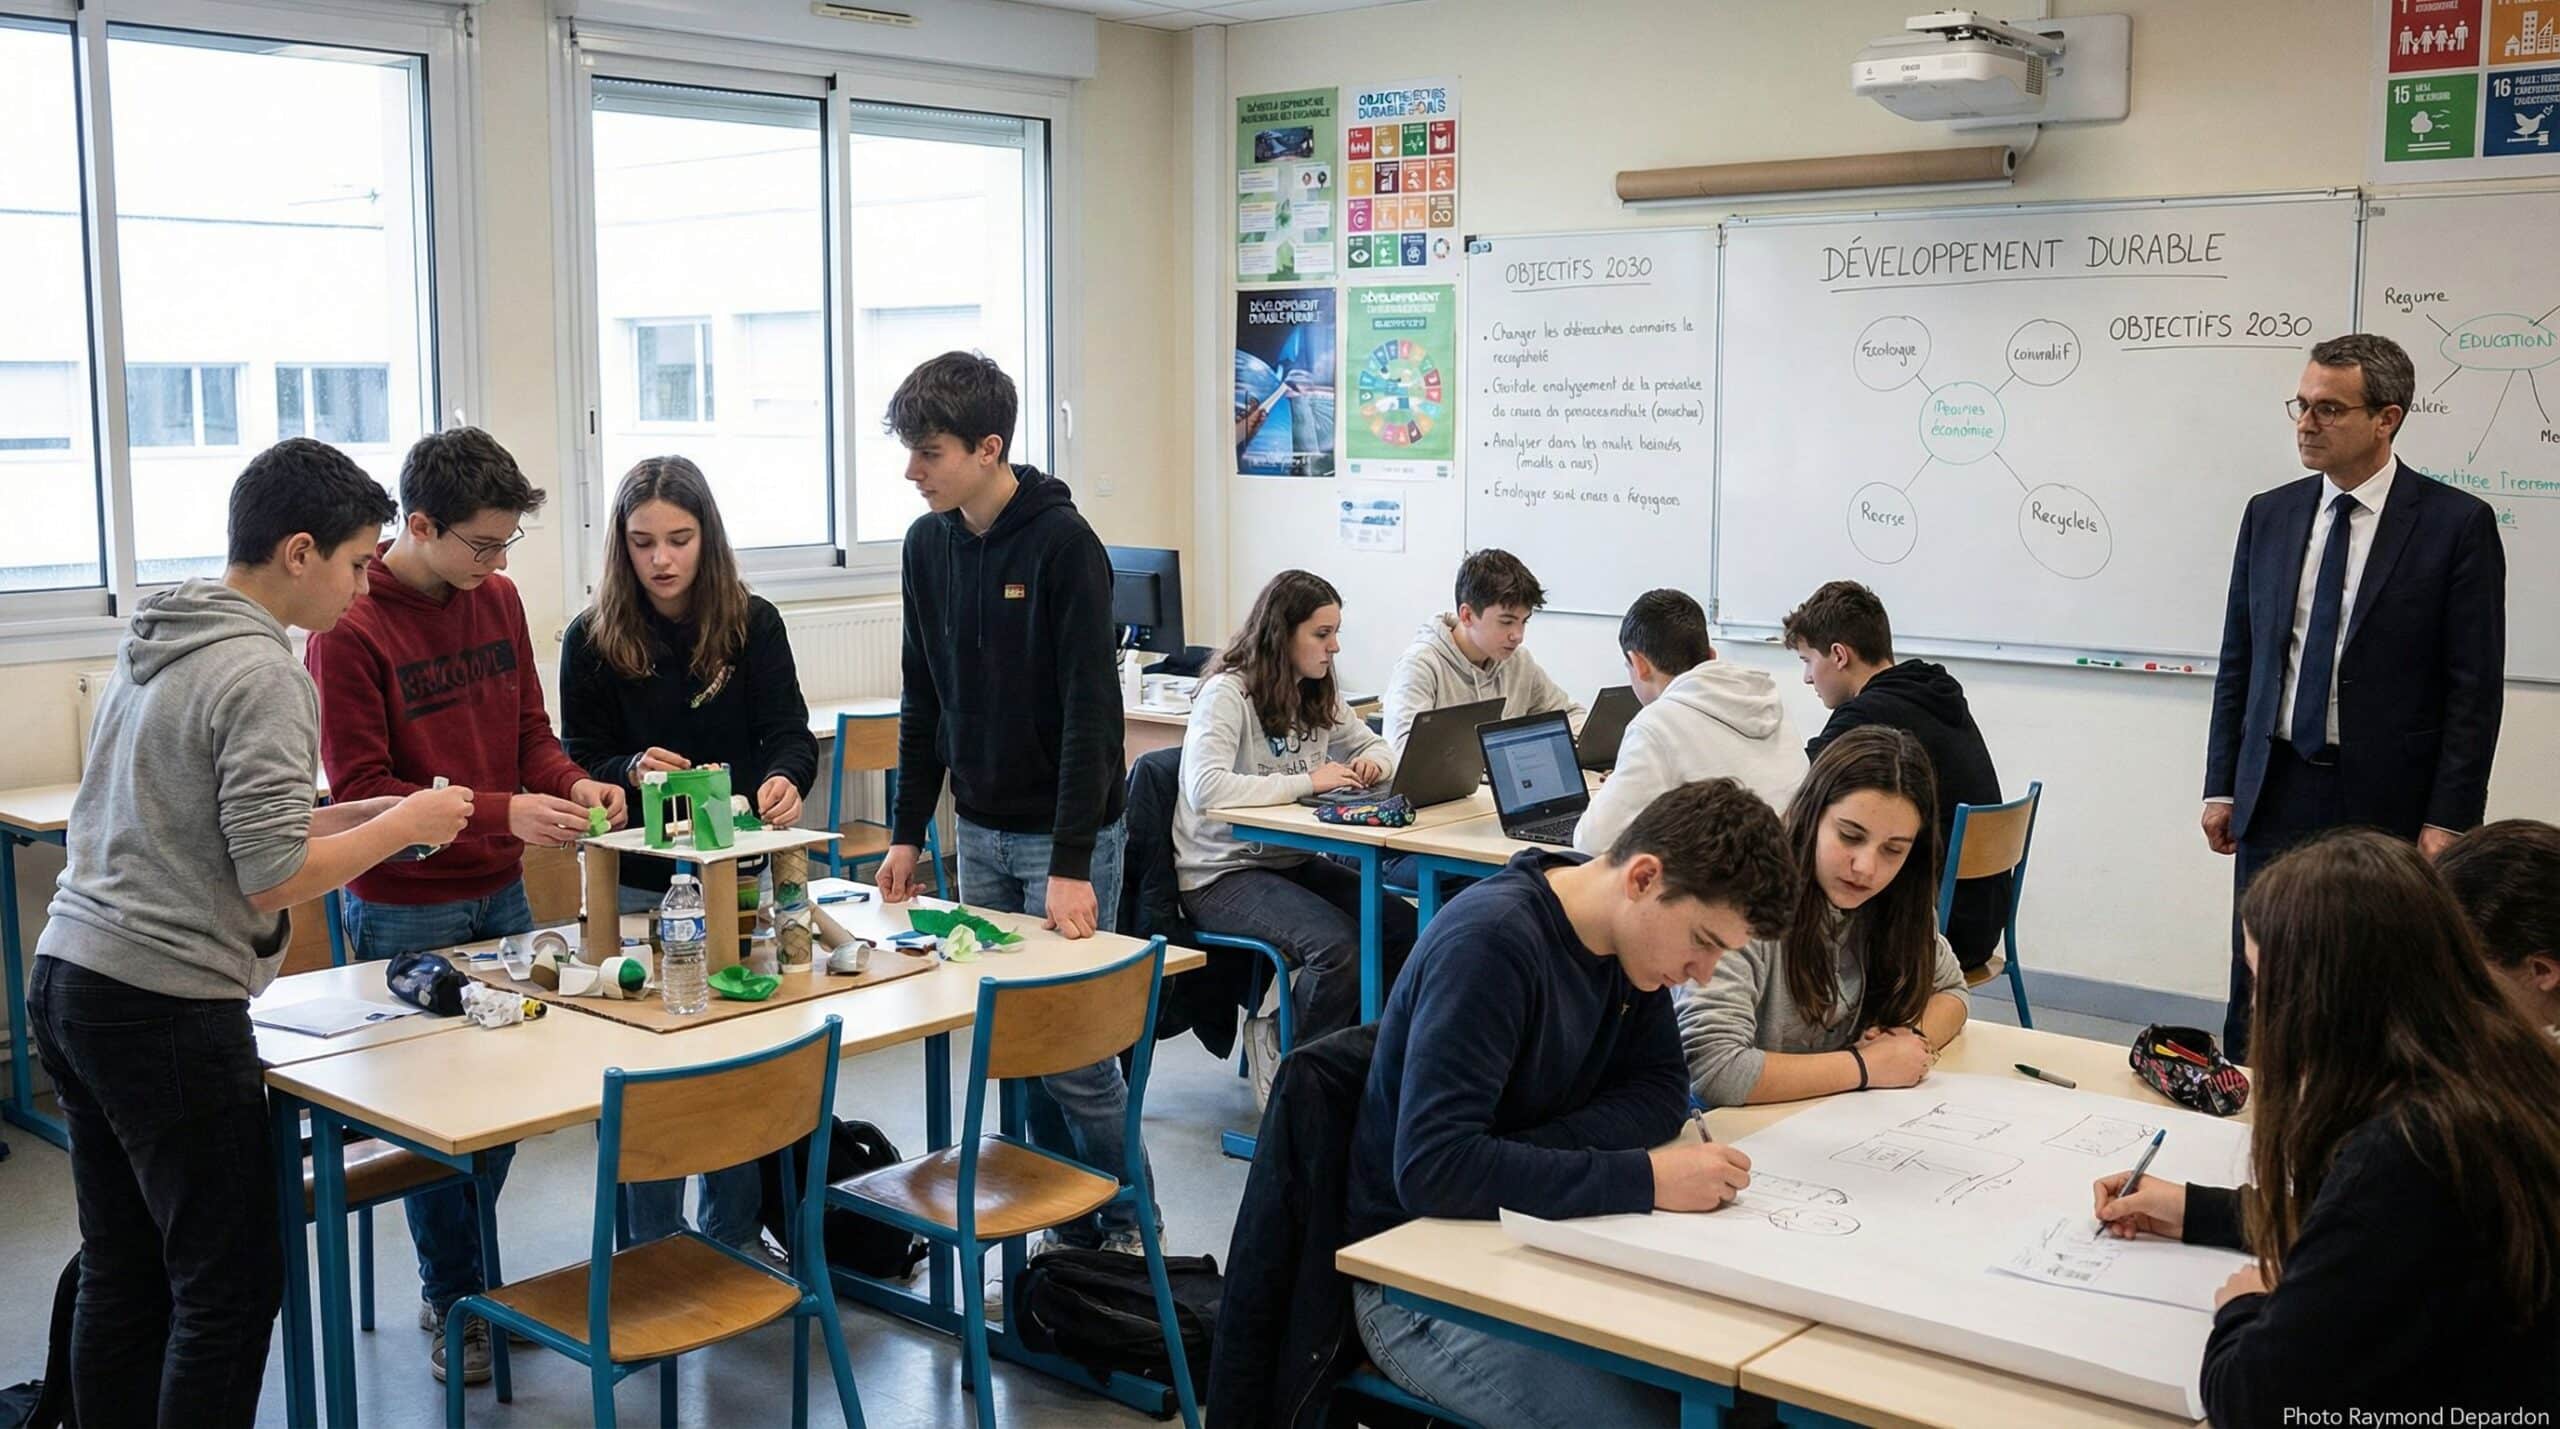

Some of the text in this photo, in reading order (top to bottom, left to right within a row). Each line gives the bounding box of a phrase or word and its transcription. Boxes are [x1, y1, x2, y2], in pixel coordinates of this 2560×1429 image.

[2393, 84, 2411, 105] 15
[2492, 77, 2512, 98] 16
[1604, 255, 1653, 280] 2030
[1819, 232, 2227, 283] DÉVELOPPEMENT DURABLE
[2246, 314, 2313, 339] 2030
[1622, 375, 1636, 392] de
[1548, 433, 1577, 449] dans
